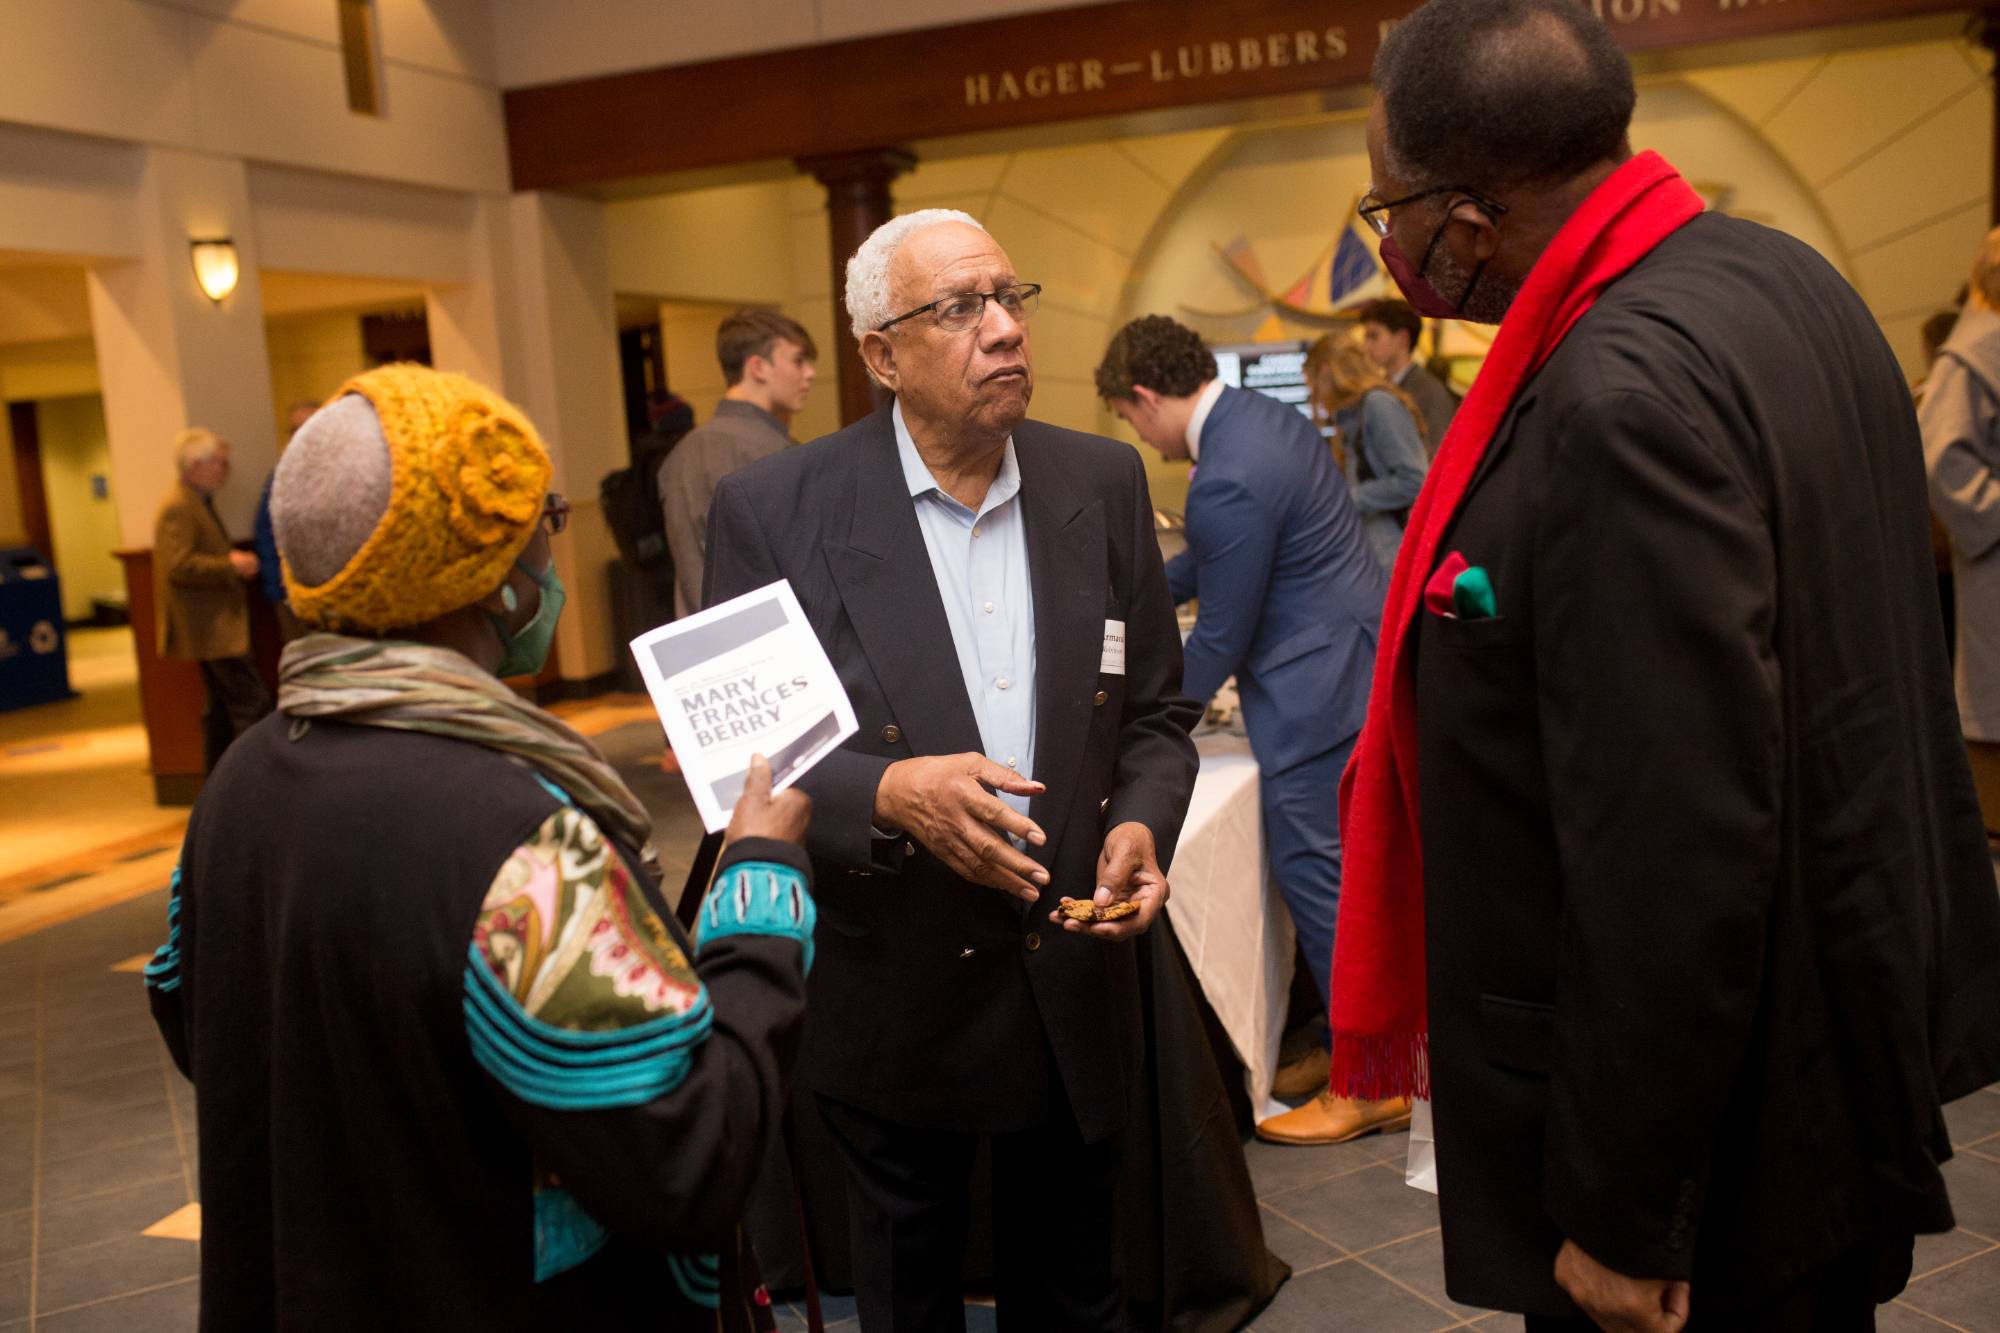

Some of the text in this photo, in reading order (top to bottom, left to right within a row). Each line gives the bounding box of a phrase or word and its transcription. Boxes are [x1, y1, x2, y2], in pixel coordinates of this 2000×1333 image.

[681, 675, 757, 714] MARY
[689, 675, 809, 730] FRANCES
[696, 705, 783, 748] BERRY
